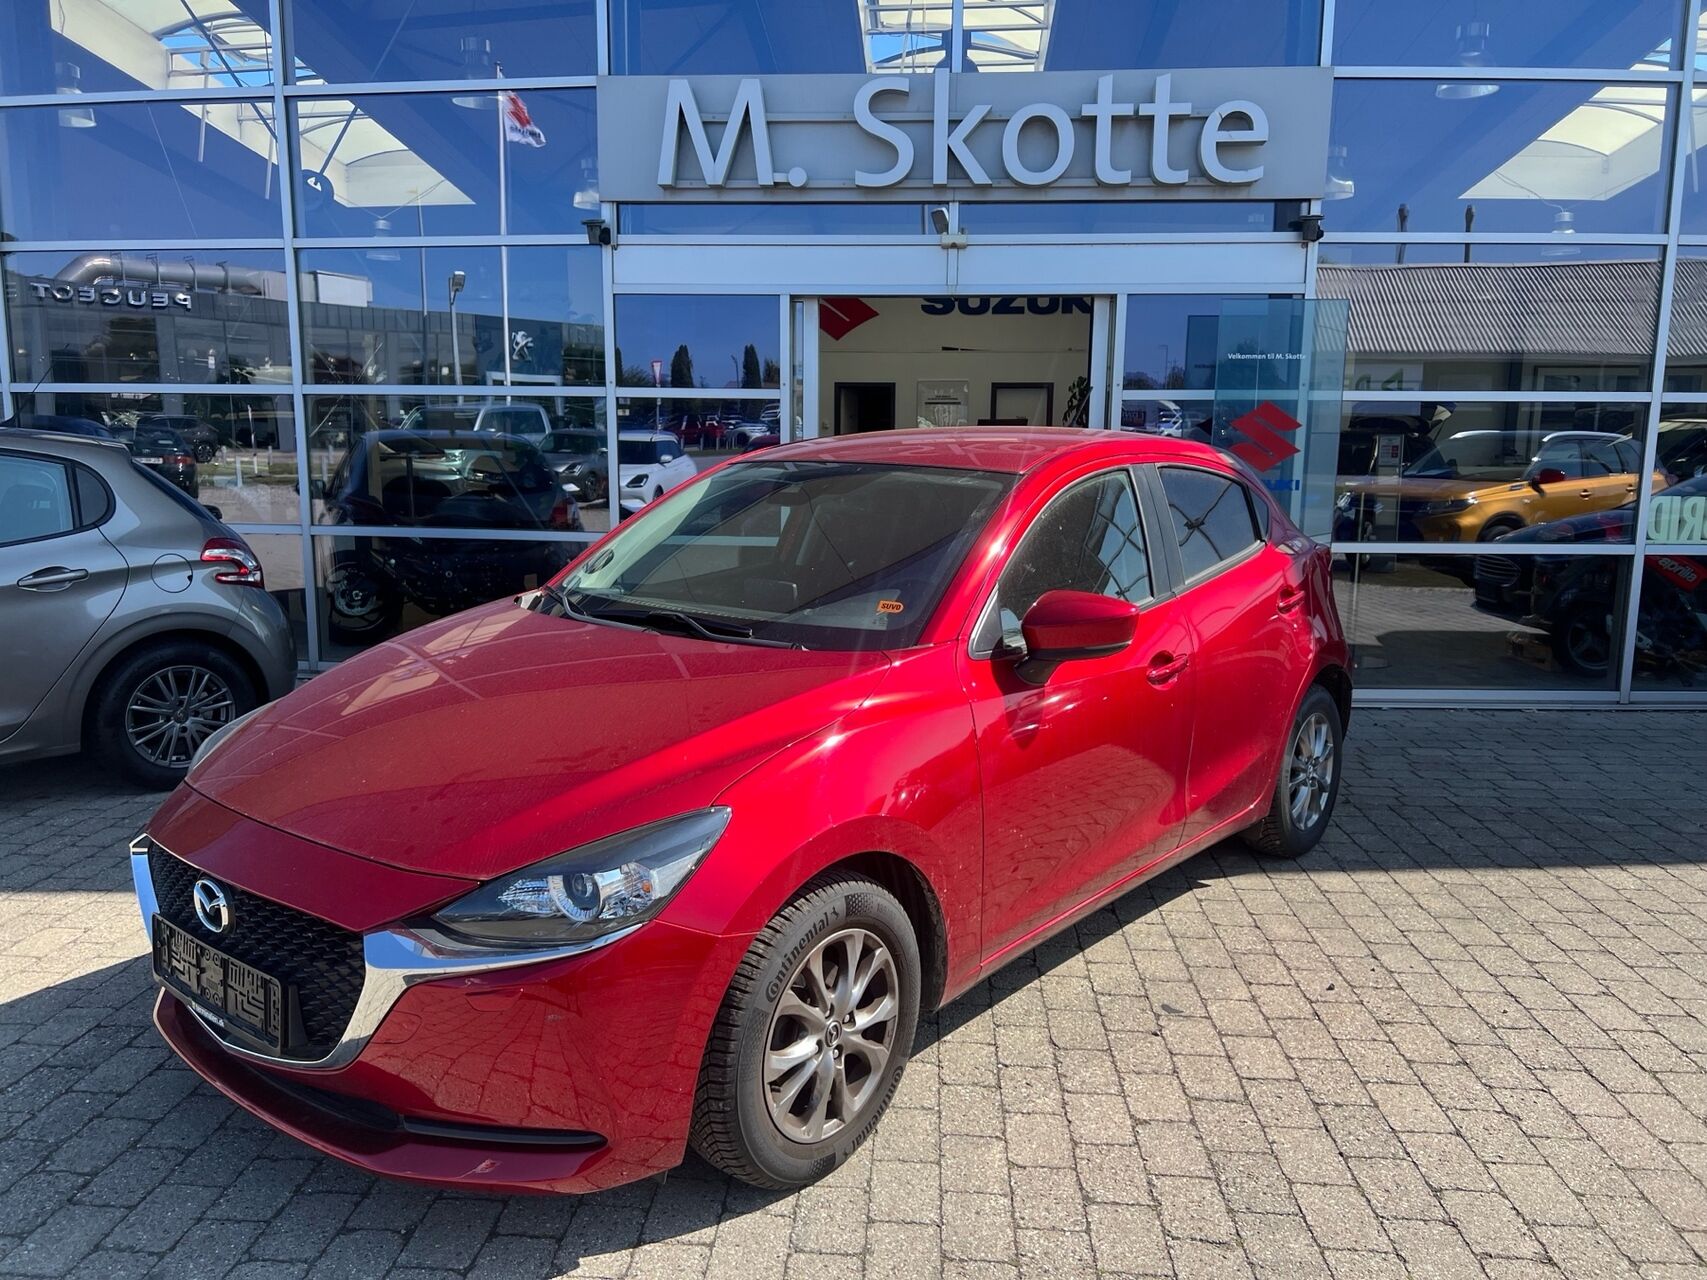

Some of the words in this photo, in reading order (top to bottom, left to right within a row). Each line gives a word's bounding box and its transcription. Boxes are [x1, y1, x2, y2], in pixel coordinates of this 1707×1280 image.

[657, 79, 809, 190] M.
[852, 66, 1270, 190] Skotte
[1658, 557, 1697, 583] aprilia
[766, 911, 830, 1003] Continental
